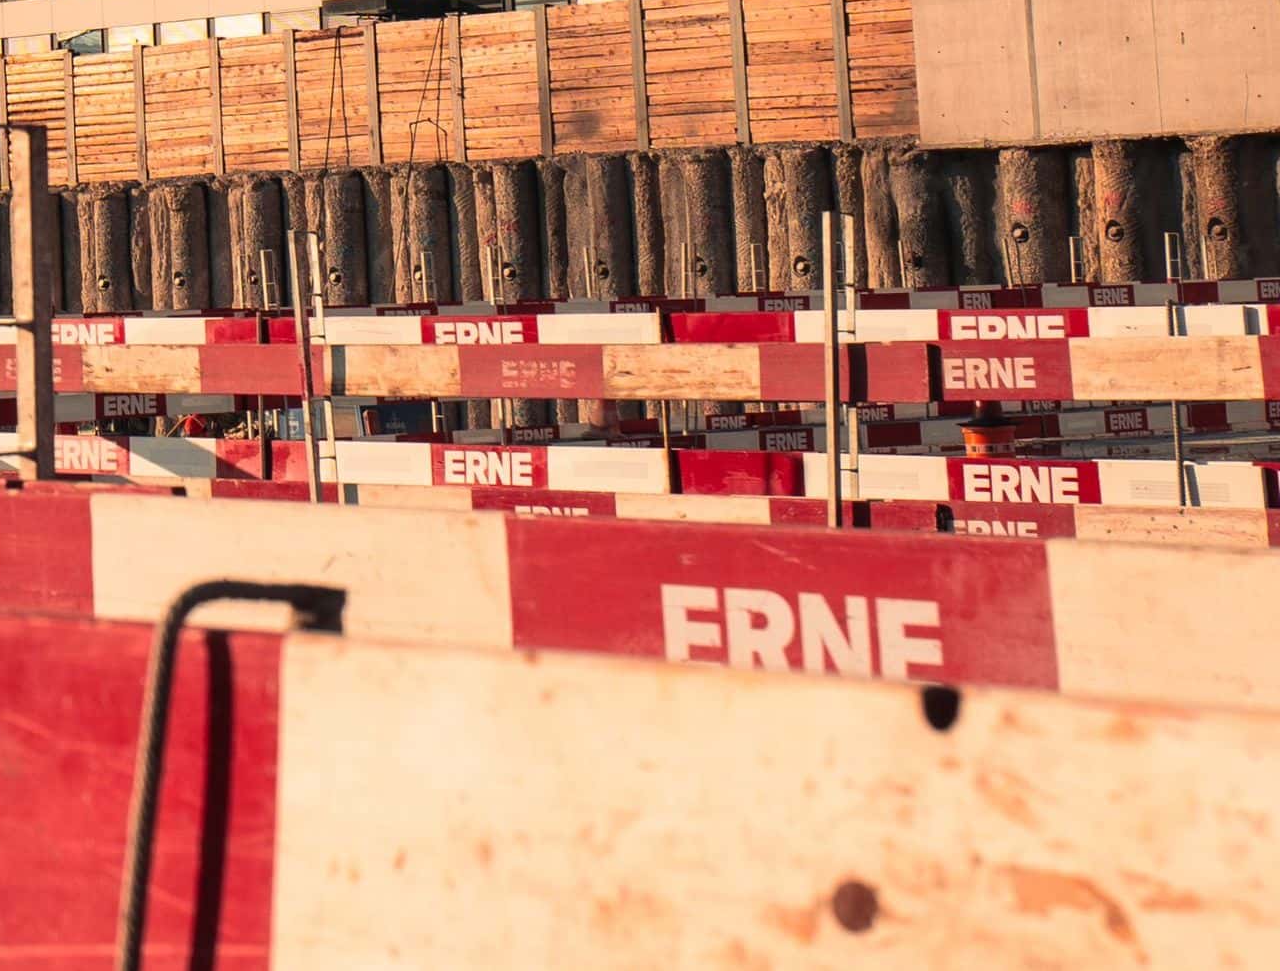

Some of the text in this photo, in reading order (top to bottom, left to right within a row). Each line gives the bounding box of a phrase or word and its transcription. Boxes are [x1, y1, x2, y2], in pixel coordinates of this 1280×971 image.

[1094, 287, 1130, 305] ERNE
[434, 322, 523, 344] ERNE
[951, 316, 1065, 340] ERNE
[942, 358, 1036, 389] ERNE
[104, 394, 157, 416] ERNE
[1110, 413, 1142, 429] ERNE
[765, 432, 807, 450] ERNE
[444, 450, 532, 486] ERNE
[963, 464, 1079, 504] ERNE
[661, 584, 943, 680] ERNE
